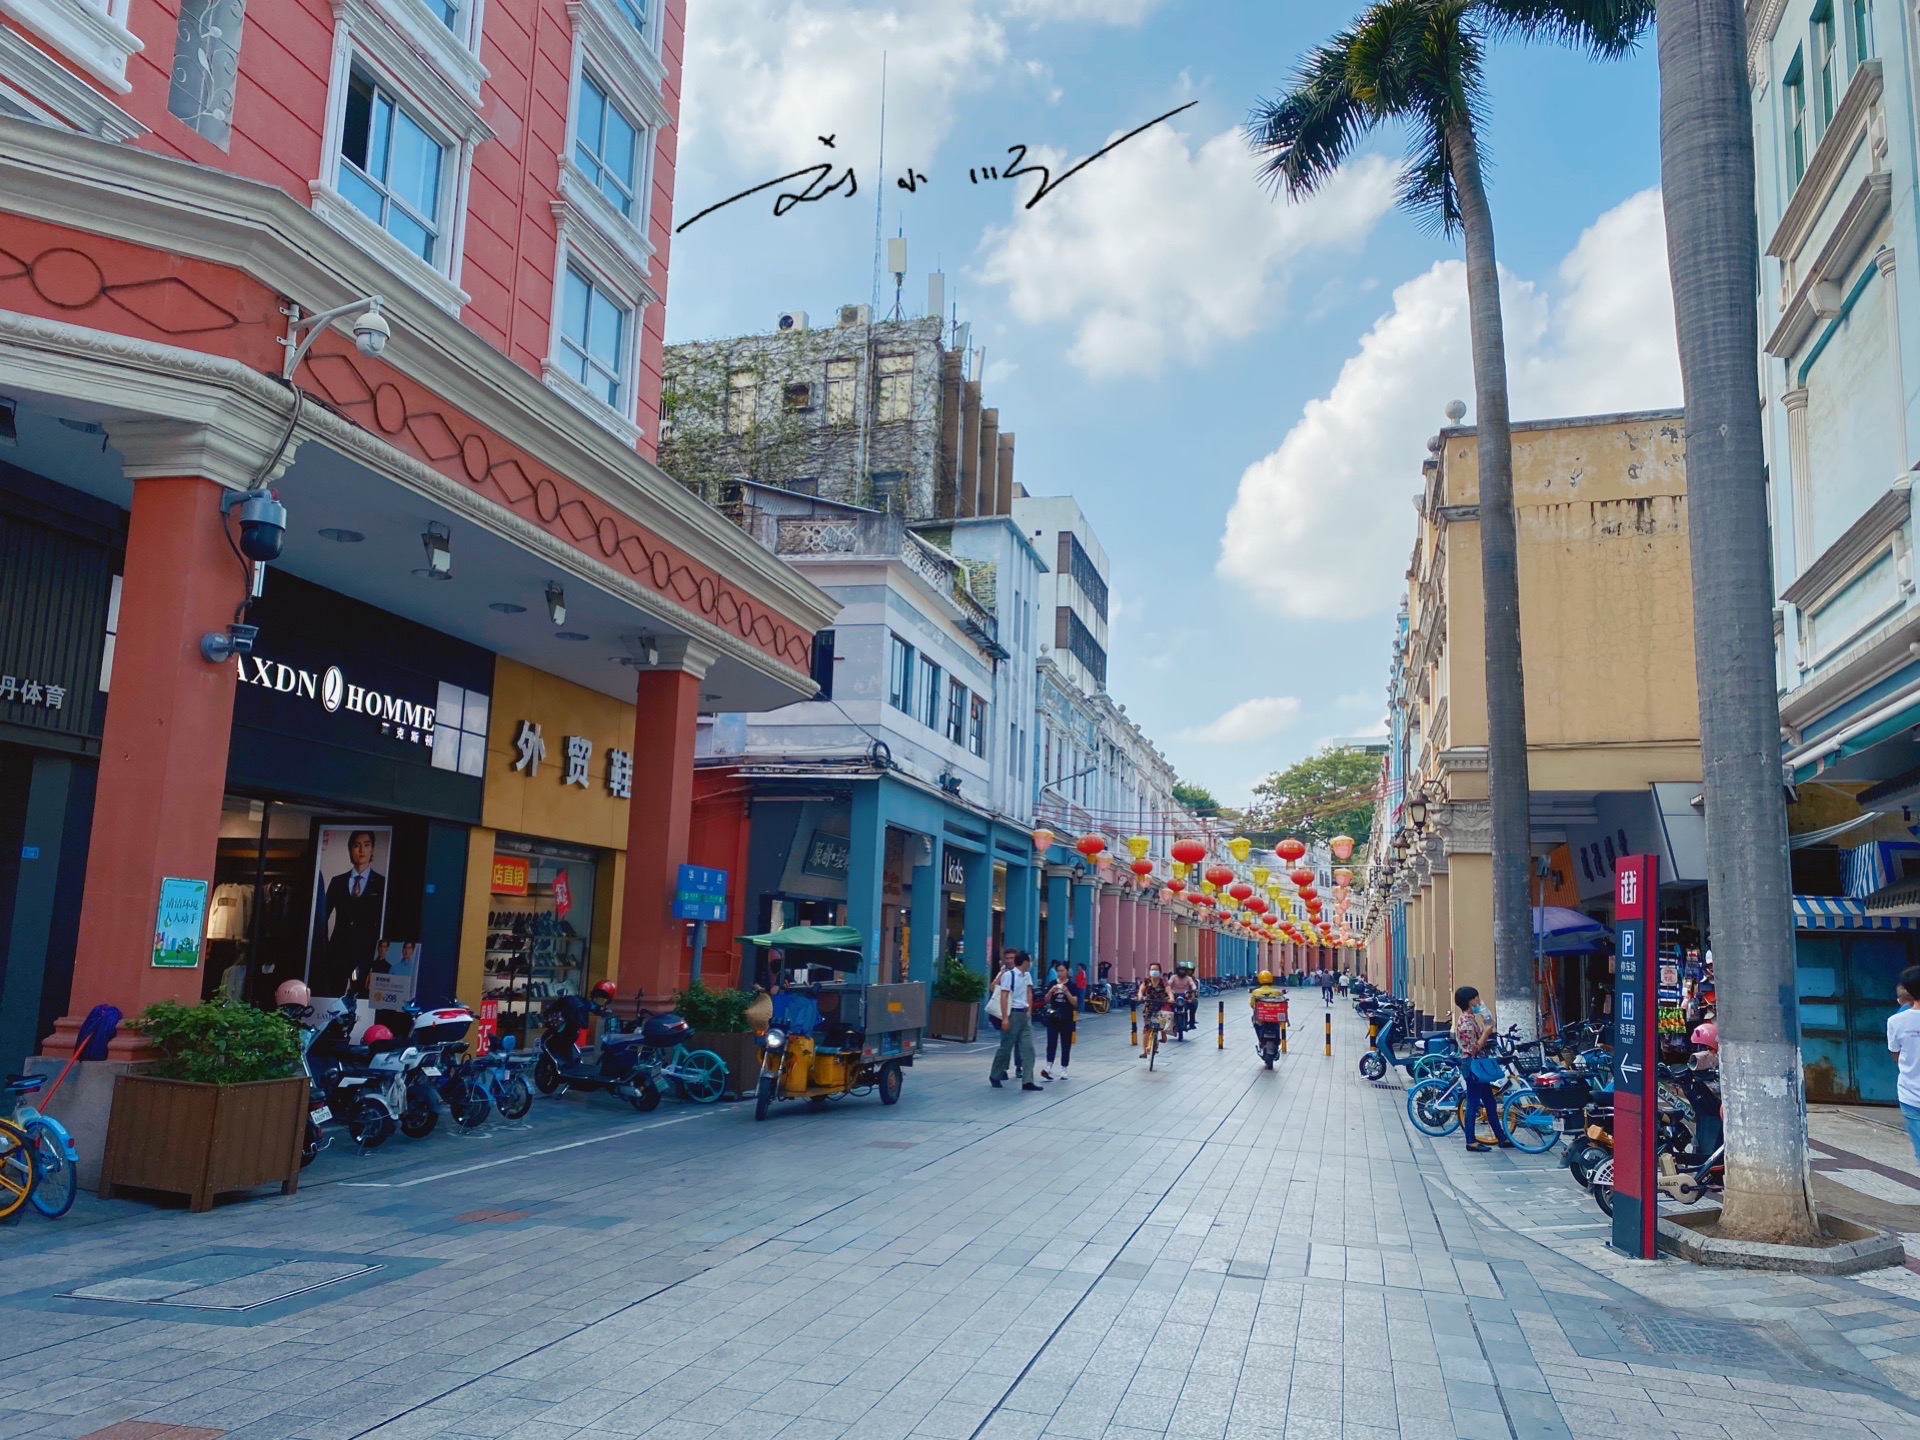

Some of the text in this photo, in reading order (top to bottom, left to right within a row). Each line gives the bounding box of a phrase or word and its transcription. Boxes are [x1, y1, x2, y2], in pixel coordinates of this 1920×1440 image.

[0, 674, 67, 710] 丹体育
[345, 683, 436, 732] HOMME
[515, 719, 633, 799] 外贸鞋
[493, 864, 526, 887] 店直销
[947, 856, 964, 885] kids
[166, 897, 198, 911] 清洁环境
[165, 912, 198, 925] 人人动手
[1620, 961, 1637, 973] 停车场
[1619, 1023, 1636, 1037] 洗手间
